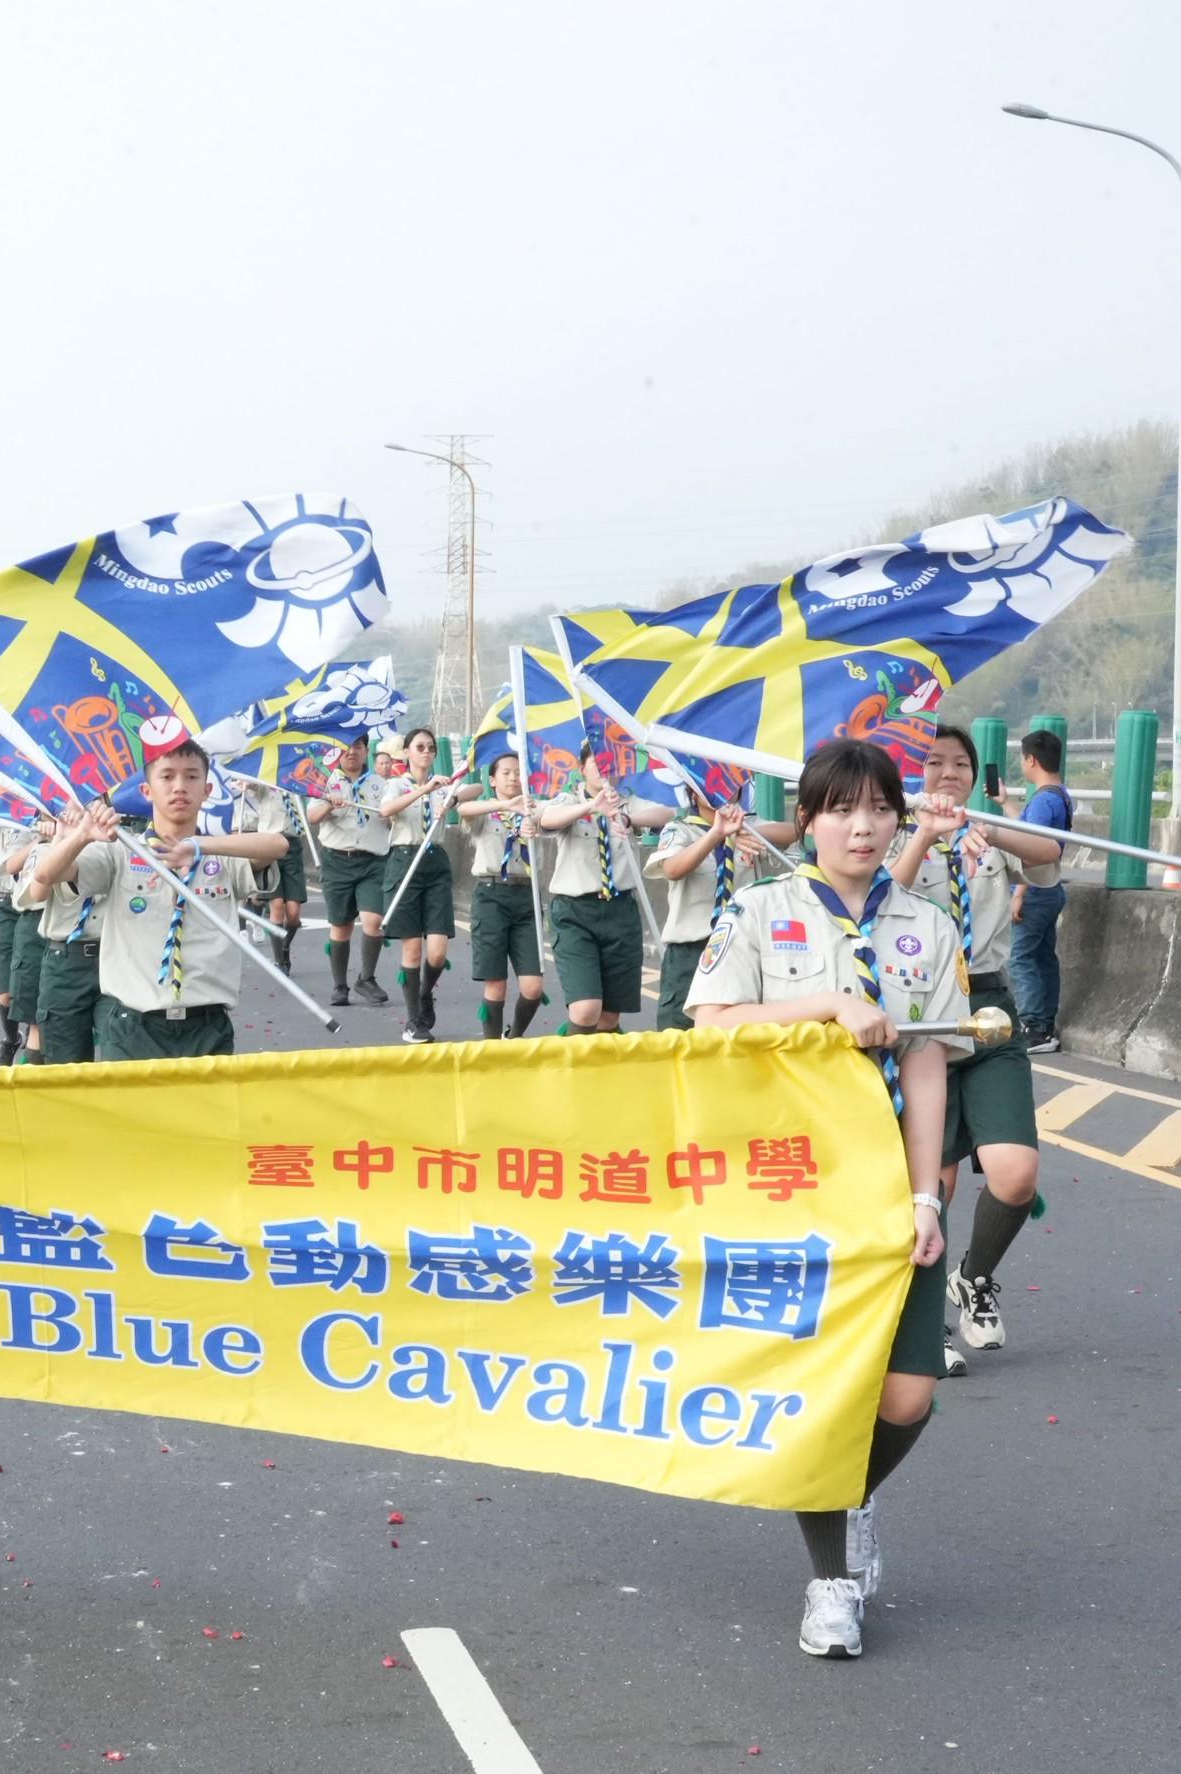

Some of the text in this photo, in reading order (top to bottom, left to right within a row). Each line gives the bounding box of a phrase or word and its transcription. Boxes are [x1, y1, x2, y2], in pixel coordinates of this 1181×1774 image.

[93, 554, 233, 595] Mingdao Scouts
[892, 565, 939, 601] Scouts
[246, 1135, 819, 1205] 臺中市明道中學
[300, 1311, 803, 1451] Cavalier
